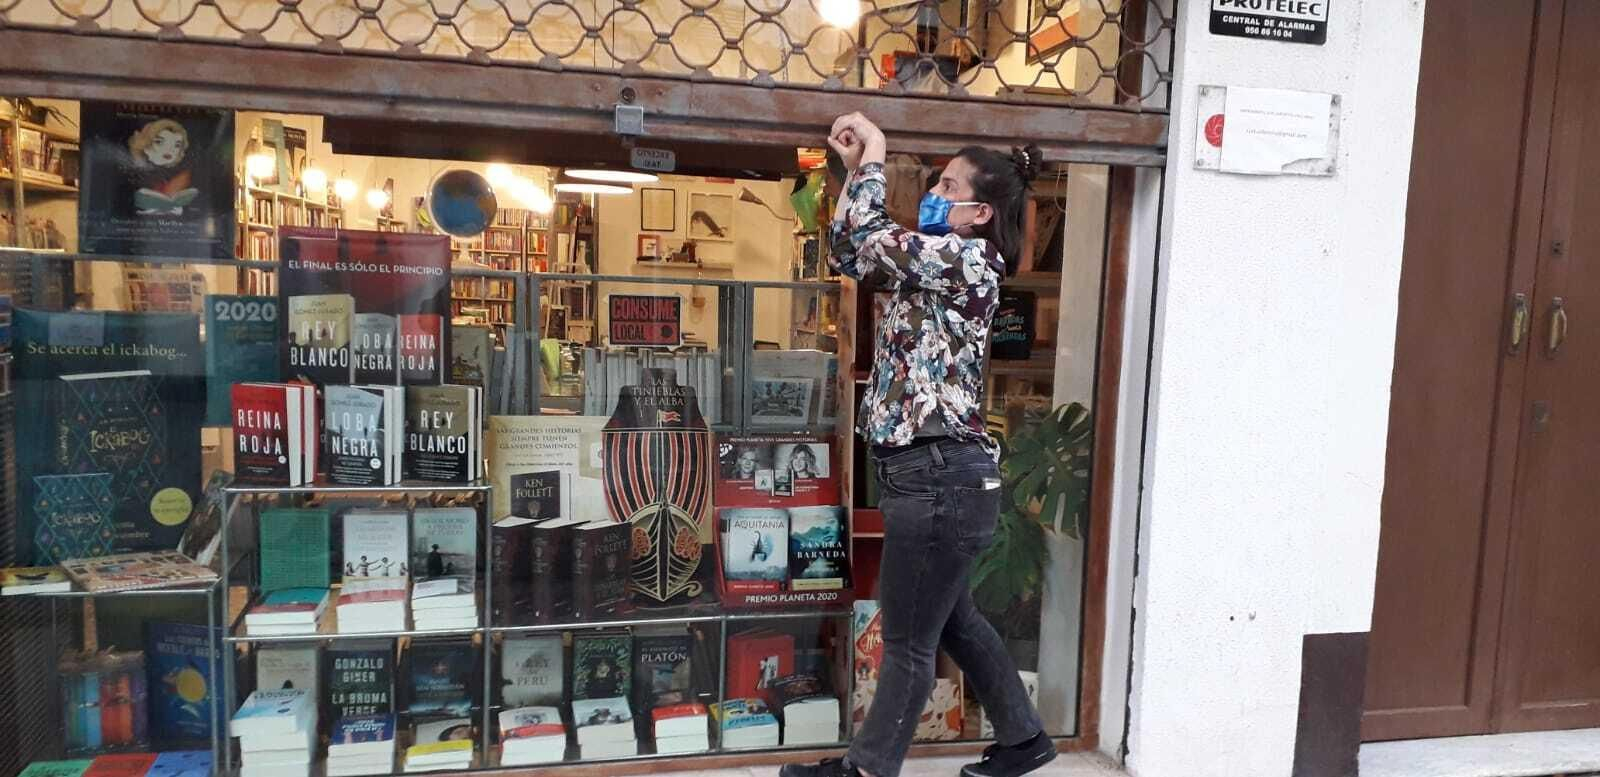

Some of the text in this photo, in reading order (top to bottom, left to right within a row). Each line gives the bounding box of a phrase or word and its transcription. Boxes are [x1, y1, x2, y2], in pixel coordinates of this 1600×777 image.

[1222, 15, 1315, 31] CENTRAL DE ALARMAS
[288, 259, 444, 276] EL FINAL ES SÓLO EL PRINCIPIO
[214, 301, 277, 321] 2020
[613, 298, 678, 320] CONSUME
[301, 320, 337, 340] REY
[613, 323, 646, 341] LOCAL
[26, 341, 45, 355] Se
[49, 345, 98, 356] acerca
[102, 344, 115, 356] el
[290, 347, 350, 368] BLANCO
[354, 354, 393, 371] NEGRA
[237, 408, 283, 431] REINA
[331, 411, 378, 434] LOBA
[420, 410, 454, 429] REY
[239, 434, 283, 456] ROJA
[332, 439, 379, 457] NEGRA
[410, 433, 467, 453] BLANCO
[525, 479, 543, 488] KEN
[516, 487, 553, 498] FOLLETT
[734, 519, 785, 529] AQUITANIA
[797, 551, 846, 559] BARNEDA
[746, 592, 838, 603] PREMIO PLANETA 2020
[335, 658, 384, 670] GONZALO
[641, 652, 688, 664] PLATÓN
[332, 693, 387, 704] LA BROMA
